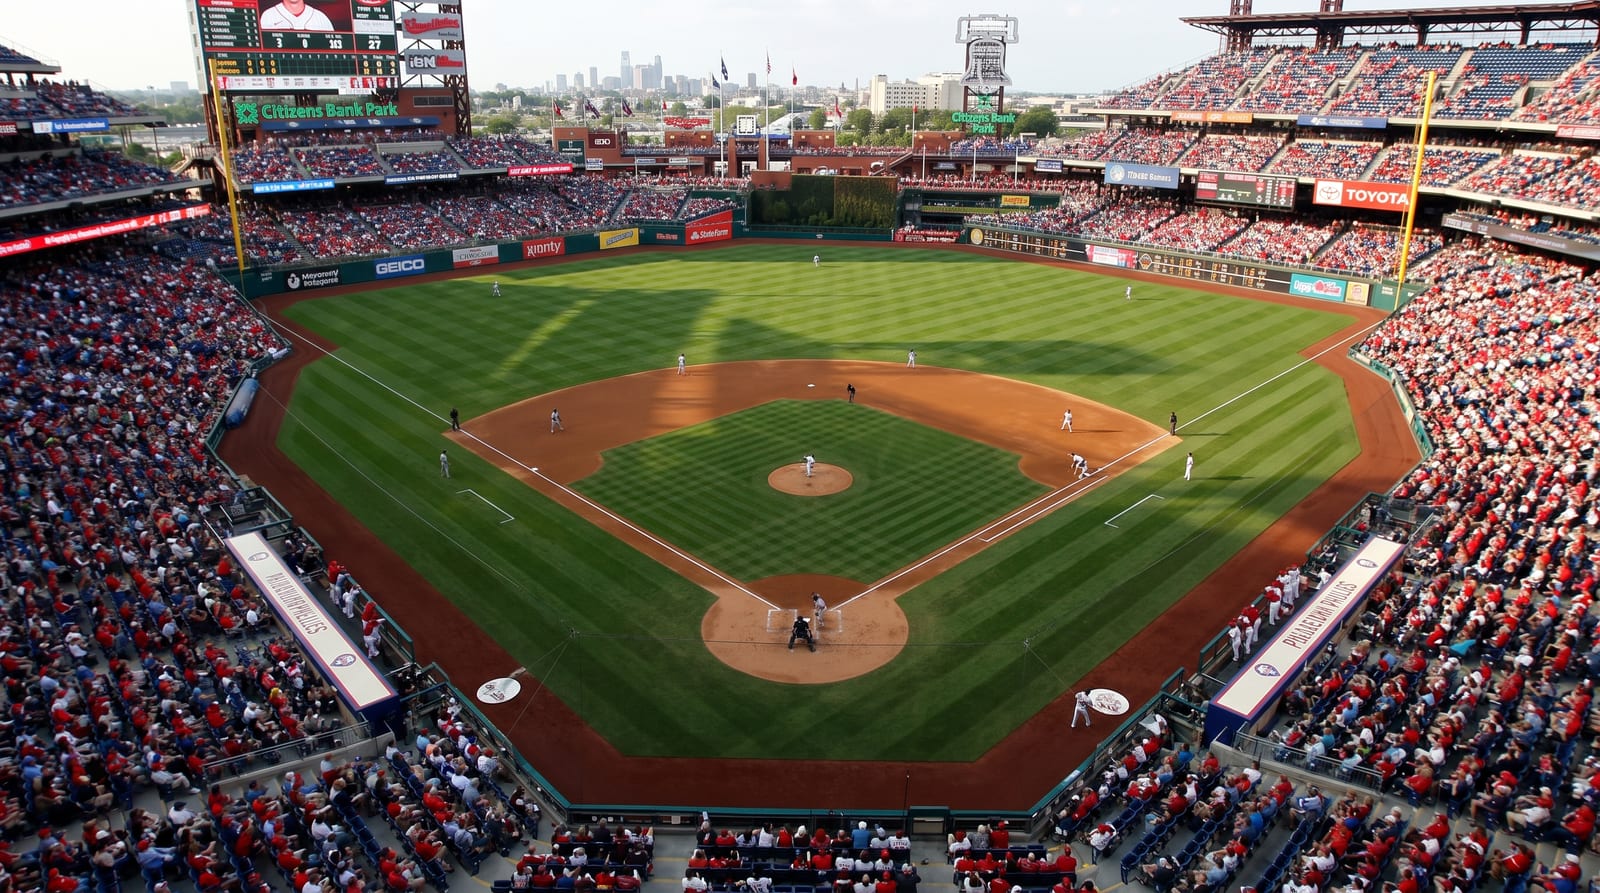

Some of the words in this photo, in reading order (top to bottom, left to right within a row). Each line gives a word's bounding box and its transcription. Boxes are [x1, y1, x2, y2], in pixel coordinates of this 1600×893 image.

[368, 40, 382, 50] 27
[261, 104, 323, 119] Citizens
[325, 101, 364, 118] Bank
[365, 101, 399, 117] Park
[952, 112, 990, 123] Citizens
[991, 112, 1016, 123] Bank
[973, 123, 995, 134] Park
[1346, 188, 1410, 205] TOYOTA
[375, 258, 425, 275] GEICO
